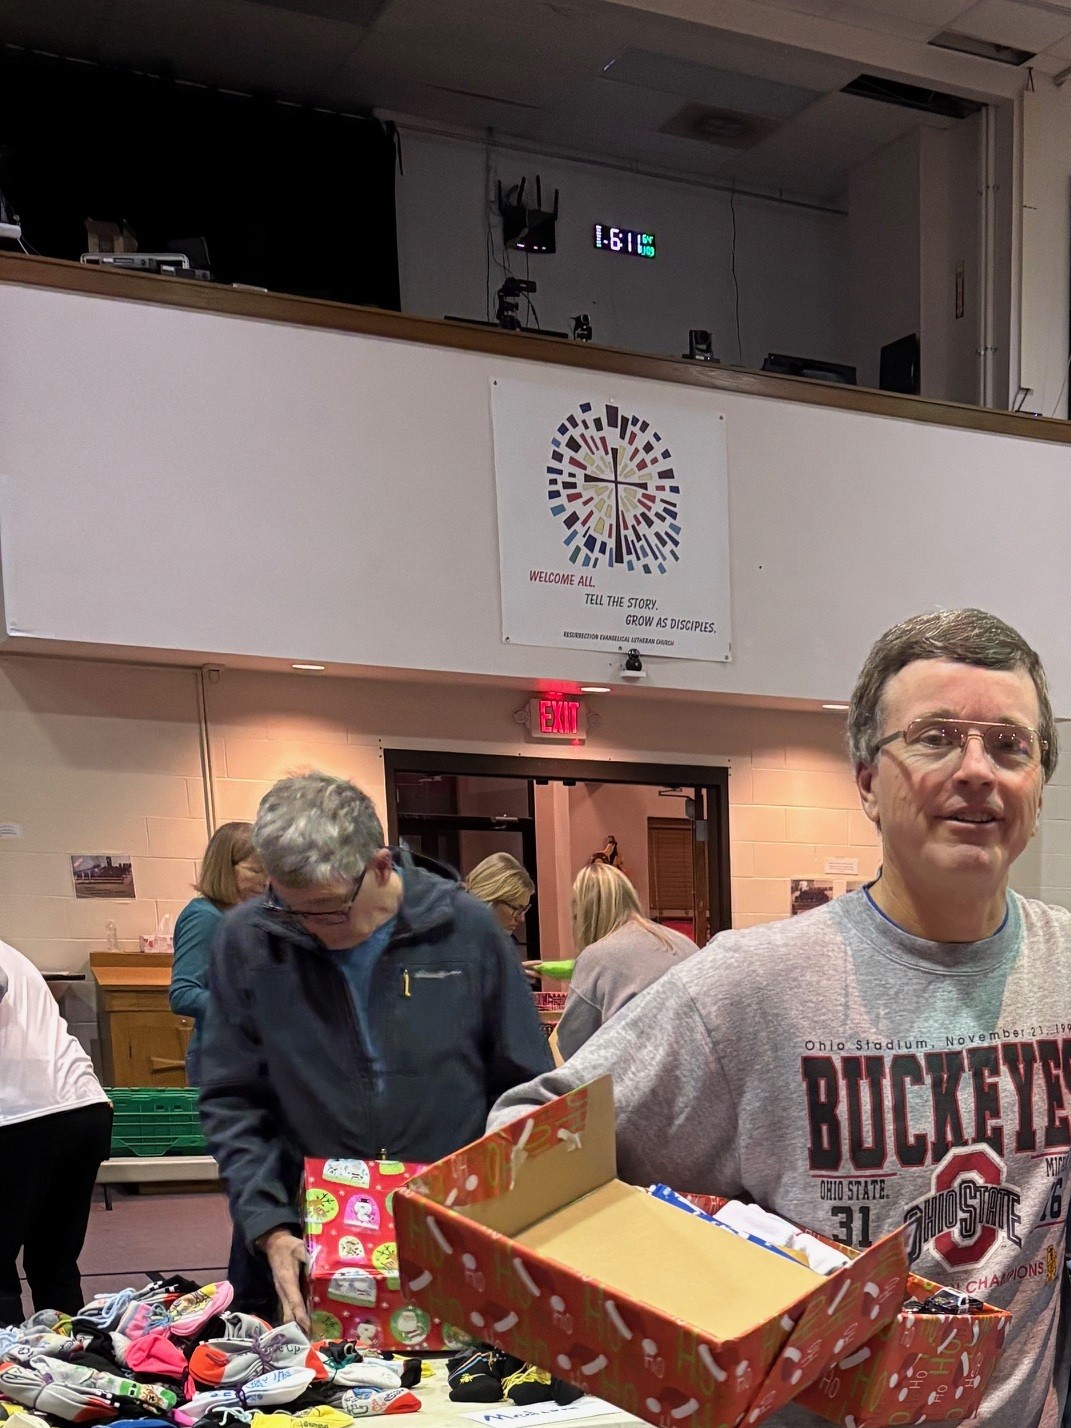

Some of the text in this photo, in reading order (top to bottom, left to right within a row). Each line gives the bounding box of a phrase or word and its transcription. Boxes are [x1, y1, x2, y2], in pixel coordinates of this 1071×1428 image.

[529, 570, 596, 588] WELCOME ALL.
[584, 593, 659, 611] TELL THE STORY.
[625, 614, 717, 634] GROW AS DISCIPLES.
[563, 631, 599, 641] RESURRECTION
[540, 700, 580, 734] EXIT
[804, 1039, 845, 1052] Ohio
[856, 1038, 936, 1051] Stadium,
[946, 1028, 1025, 1047] November
[819, 1179, 844, 1201] OHIO
[830, 1205, 874, 1248] 31
